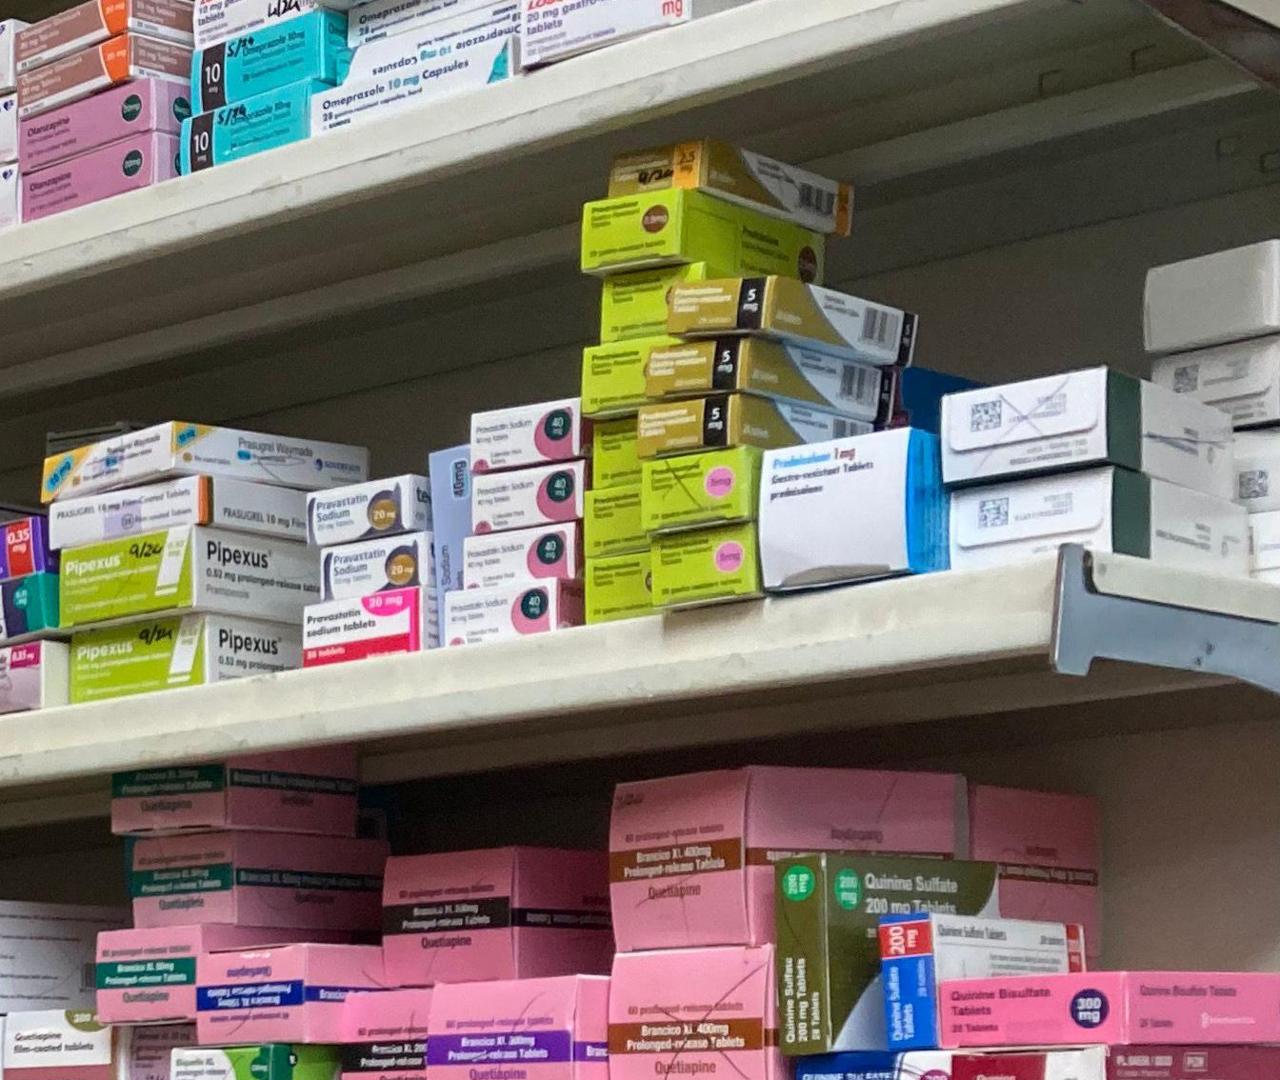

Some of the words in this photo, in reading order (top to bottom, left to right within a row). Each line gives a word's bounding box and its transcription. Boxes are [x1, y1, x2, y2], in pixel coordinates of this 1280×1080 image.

[205, 63, 221, 83] 10
[322, 85, 385, 110] Omeprazole
[388, 78, 401, 90] 10
[402, 73, 420, 89] mg
[422, 58, 469, 80] Capsules
[194, 131, 209, 152] 10
[747, 288, 756, 301] 5
[743, 303, 758, 312] mg
[722, 350, 730, 362] 5
[711, 407, 720, 420] 5
[555, 479, 567, 489] 40
[316, 494, 368, 511] Pravastatin
[317, 508, 351, 522] Sodium
[8, 528, 30, 544] 0.35
[545, 540, 556, 551] 40
[334, 548, 387, 565] Pravastatin
[65, 554, 122, 576] Pipexus
[334, 564, 368, 576] Sodium
[528, 596, 540, 606] 40
[307, 610, 362, 625] Pravastatin
[306, 623, 341, 637] sodium
[344, 619, 376, 632] tablets
[76, 640, 134, 660] Pipexus
[865, 873, 912, 891] Quinine
[916, 876, 958, 893] Sulfate
[648, 883, 701, 900] Quetiapine
[890, 926, 905, 954] 200
[951, 989, 996, 1001] Quinine
[999, 987, 1051, 999] Bisulfate
[951, 1005, 991, 1016] Tablets
[1079, 1010, 1100, 1023] mg
[786, 999, 796, 1043] Quinine
[15, 1032, 62, 1042] Quetiapine
[14, 1043, 62, 1053] film-coated
[65, 1042, 94, 1051] tablets
[655, 1061, 716, 1076] Quetiapine
